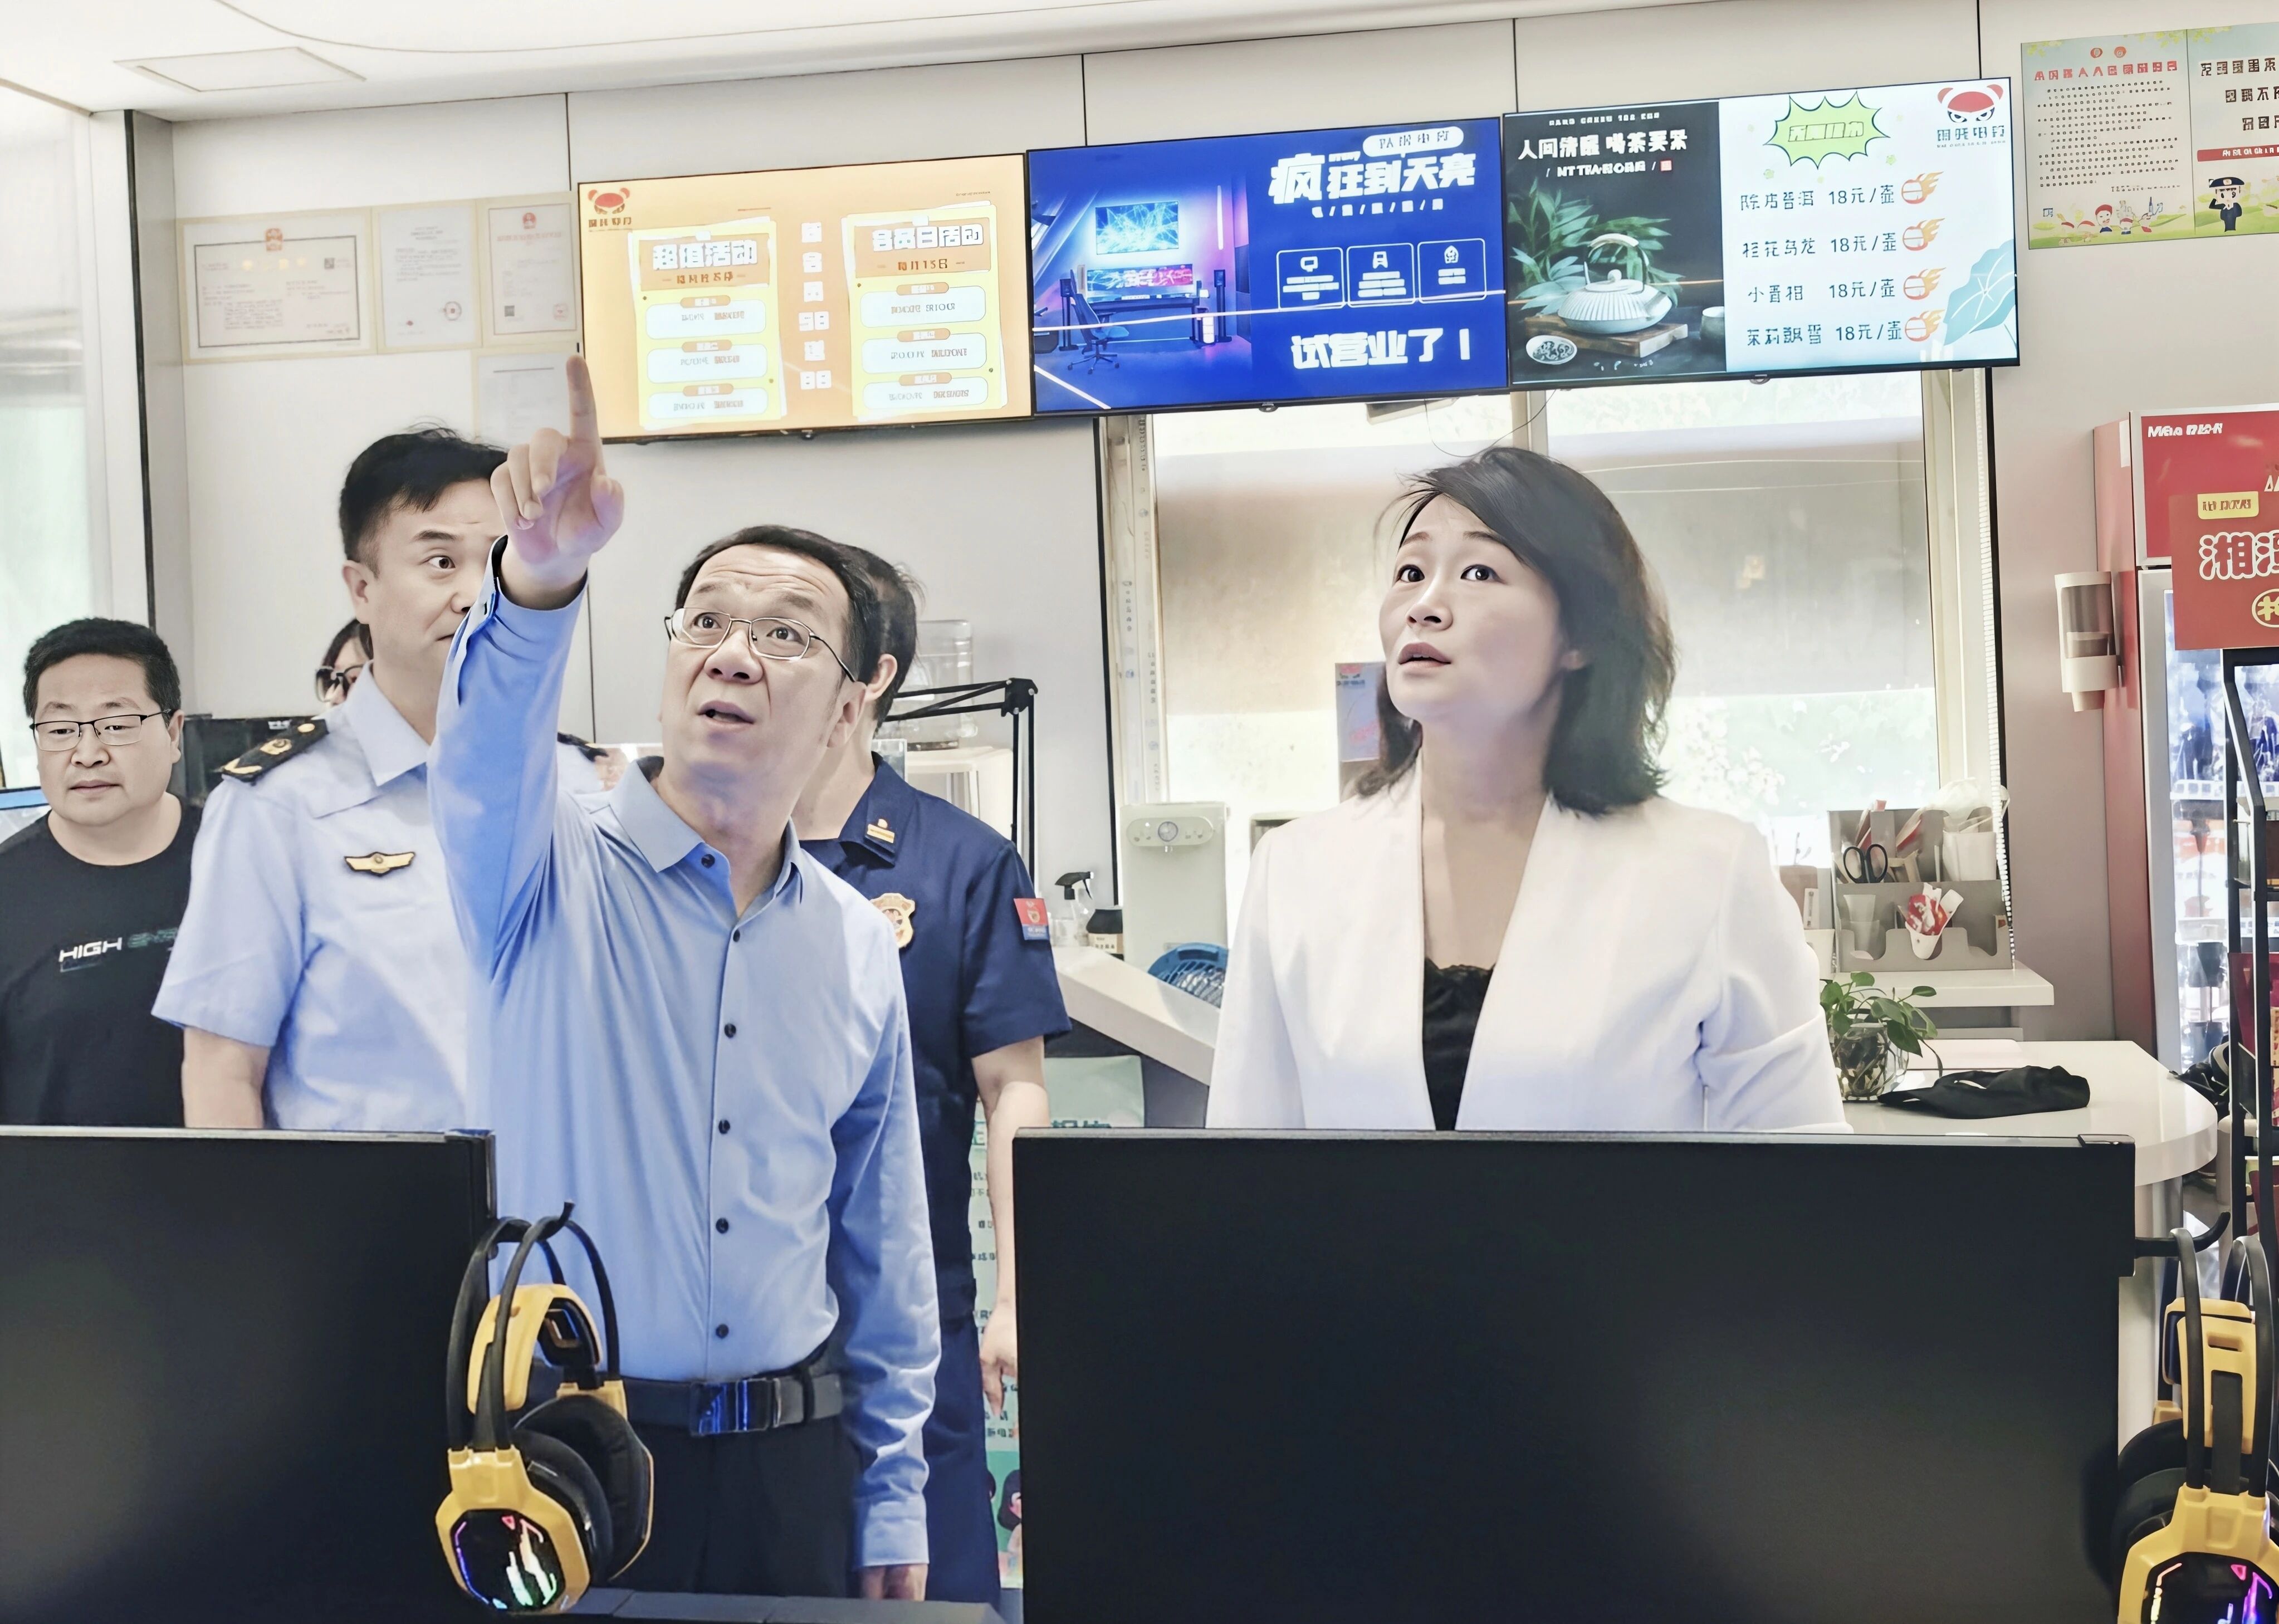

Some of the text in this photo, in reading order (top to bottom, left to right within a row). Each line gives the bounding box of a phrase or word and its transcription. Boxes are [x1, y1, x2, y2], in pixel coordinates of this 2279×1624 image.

[1268, 152, 1476, 204] 疯狂到天亮
[58, 937, 123, 962] HIGH
